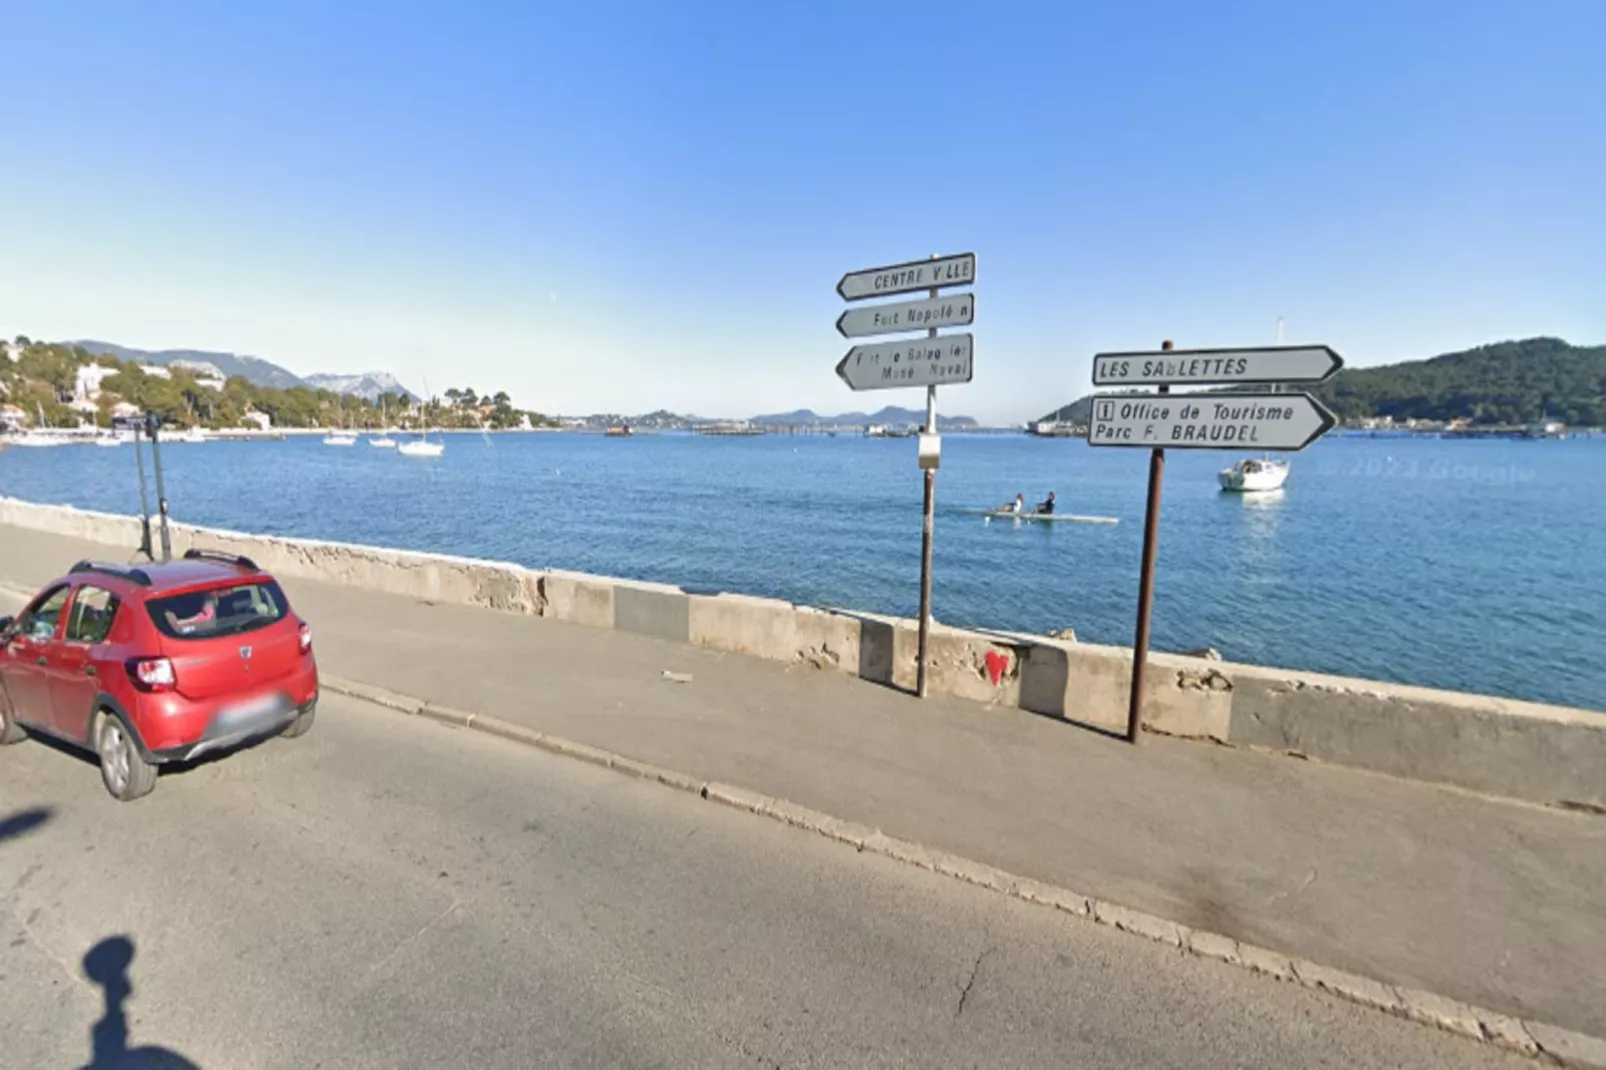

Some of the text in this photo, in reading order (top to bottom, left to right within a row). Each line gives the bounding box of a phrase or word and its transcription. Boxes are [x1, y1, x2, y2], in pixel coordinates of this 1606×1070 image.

[874, 261, 970, 290] CENTRE VLLE
[907, 304, 968, 324] Napolén
[856, 351, 880, 367] Frt
[1099, 360, 1130, 379] LES
[1120, 402, 1170, 421] Office
[1180, 402, 1200, 420] de
[1213, 402, 1294, 421] Tourisme
[1095, 423, 1259, 442] Parc F. BRAUDEL
